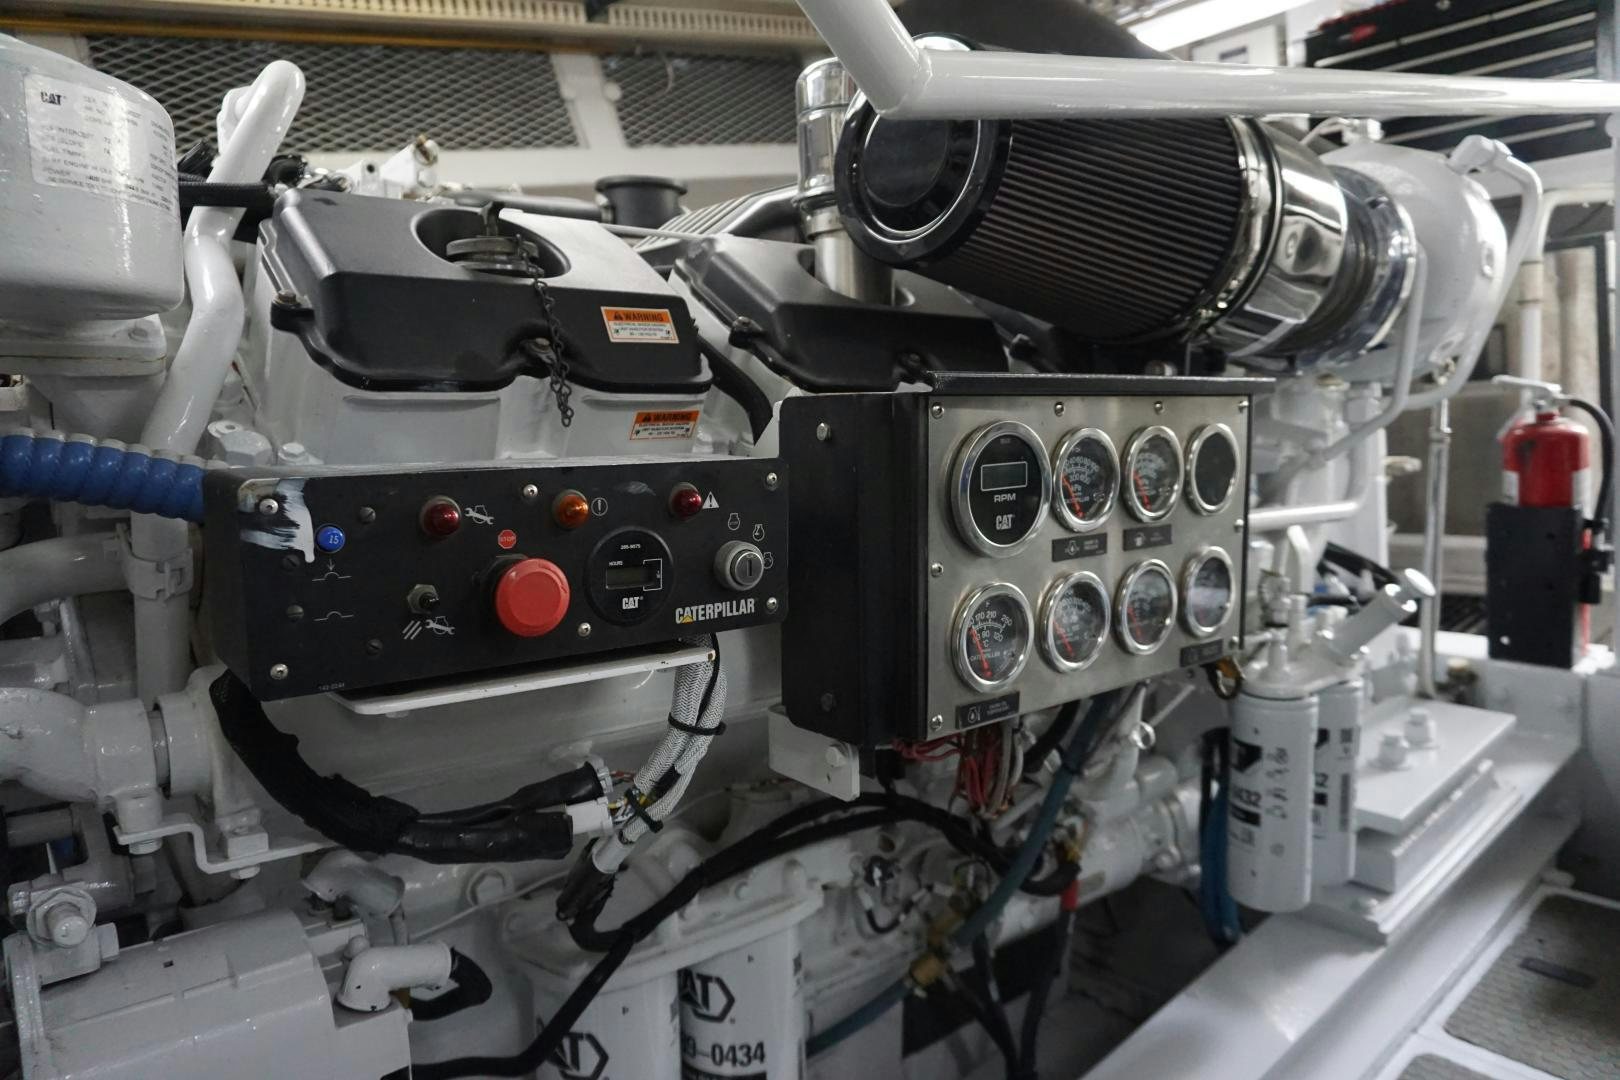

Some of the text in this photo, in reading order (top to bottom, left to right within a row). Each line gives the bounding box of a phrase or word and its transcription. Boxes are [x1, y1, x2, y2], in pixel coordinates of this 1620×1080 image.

[41, 91, 62, 106] CAT
[624, 311, 663, 322] WARNING
[993, 492, 1016, 503] RPM
[995, 513, 1014, 530] CAT
[622, 597, 640, 610] CAT
[675, 598, 756, 625] CATERPILLAR
